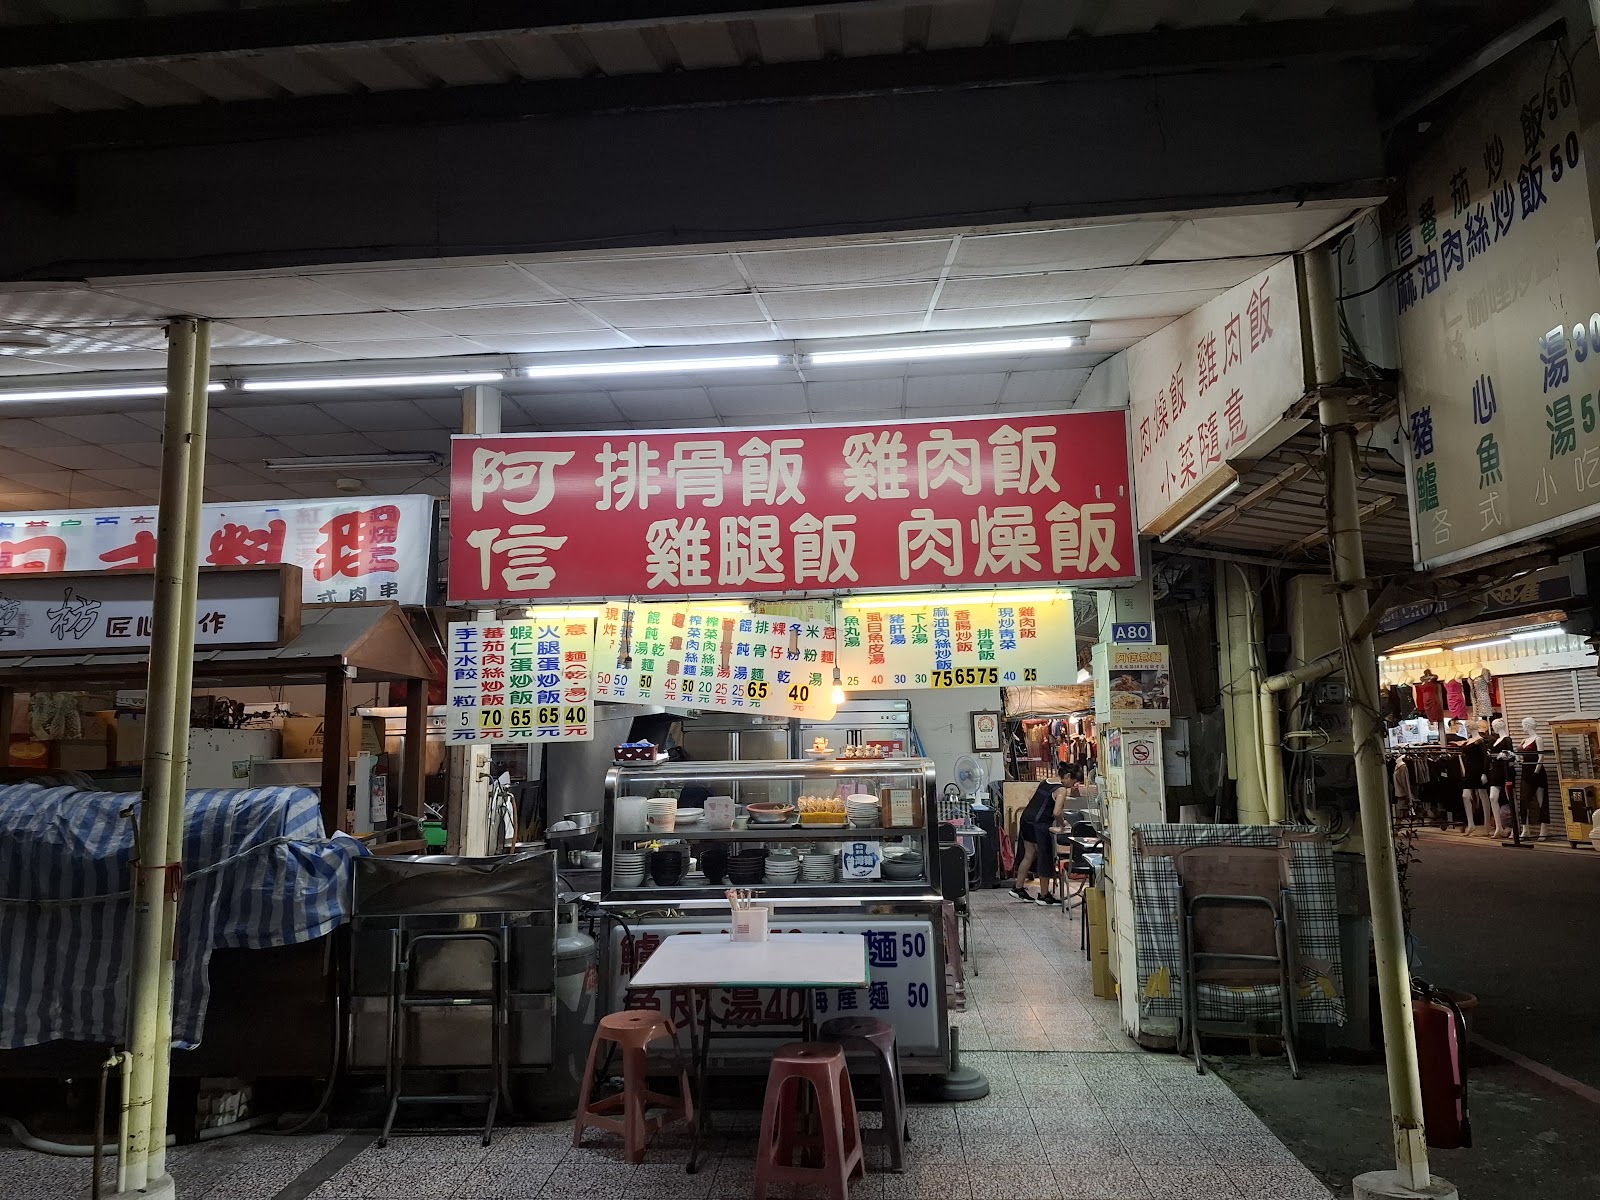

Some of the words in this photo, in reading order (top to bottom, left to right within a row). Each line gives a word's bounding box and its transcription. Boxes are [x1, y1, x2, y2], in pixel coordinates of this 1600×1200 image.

[1396, 151, 1547, 315] 麻油肉絲炒飯
[1550, 130, 1579, 183] 50
[1139, 362, 1187, 463] 肉燥飯
[1197, 275, 1274, 397] 雞肉飯
[1411, 324, 1569, 459] 豬心湯
[1161, 387, 1248, 502] 小菜隨意
[1416, 394, 1577, 514] 鱸魚湯
[594, 436, 806, 511] 排骨飯
[842, 424, 1060, 503] 雞肉飯
[1432, 446, 1600, 545] 各式小吃
[466, 447, 576, 592] 阿信
[646, 512, 859, 589] 雞腿飯
[898, 500, 1121, 580] 肉燥飯
[645, 611, 660, 641] 餛飩
[844, 615, 860, 647] 魚丸湯
[911, 613, 928, 644] 下水湯
[954, 610, 973, 653] 香腸炒飯
[998, 608, 1017, 650] 現炒青菜
[1018, 607, 1036, 639] 雞肉飯
[866, 612, 885, 664] 虱目魚皮湯
[933, 607, 952, 670] 麻油肉絲炒飯
[1116, 626, 1148, 639] A80
[683, 615, 702, 676] 榨菜肉絲麵
[700, 616, 719, 677] 榨菜肉絲湯
[734, 619, 752, 680] 餛飩湯
[751, 620, 769, 681] 排骨麵
[804, 625, 819, 662] 米粉
[821, 626, 837, 664] 意麵
[977, 629, 995, 661] 排骨飯
[453, 628, 478, 707] 手工水餃一粒
[509, 625, 533, 704] 蝦仁蛋炒飯
[537, 625, 560, 704] 火腿蛋炒飯
[597, 672, 611, 684] 50
[613, 674, 627, 686] 50
[640, 675, 652, 688] 50
[847, 677, 859, 686] 25
[872, 675, 883, 684] 40
[894, 674, 906, 684] 30
[915, 674, 927, 683] 30
[932, 671, 952, 686] 75
[955, 668, 975, 684] 65
[978, 668, 998, 684] 75
[1004, 671, 1016, 681] 40
[1024, 668, 1036, 681] 25
[665, 678, 677, 690] 45
[682, 680, 694, 692] 50
[698, 681, 712, 693] 20
[715, 683, 728, 695] 25
[732, 684, 744, 696] 25
[747, 682, 768, 698] 65
[789, 685, 809, 701] 40
[461, 711, 469, 726] 5
[481, 710, 501, 726] 70
[511, 709, 531, 726] 65
[539, 707, 559, 724] 65
[565, 707, 586, 723] 40
[452, 729, 476, 740] 元
[480, 728, 504, 739] 元
[509, 726, 533, 737] 元
[537, 726, 560, 737] 元
[564, 725, 587, 736] 元
[902, 933, 925, 957] 50
[908, 983, 929, 1008] 50
